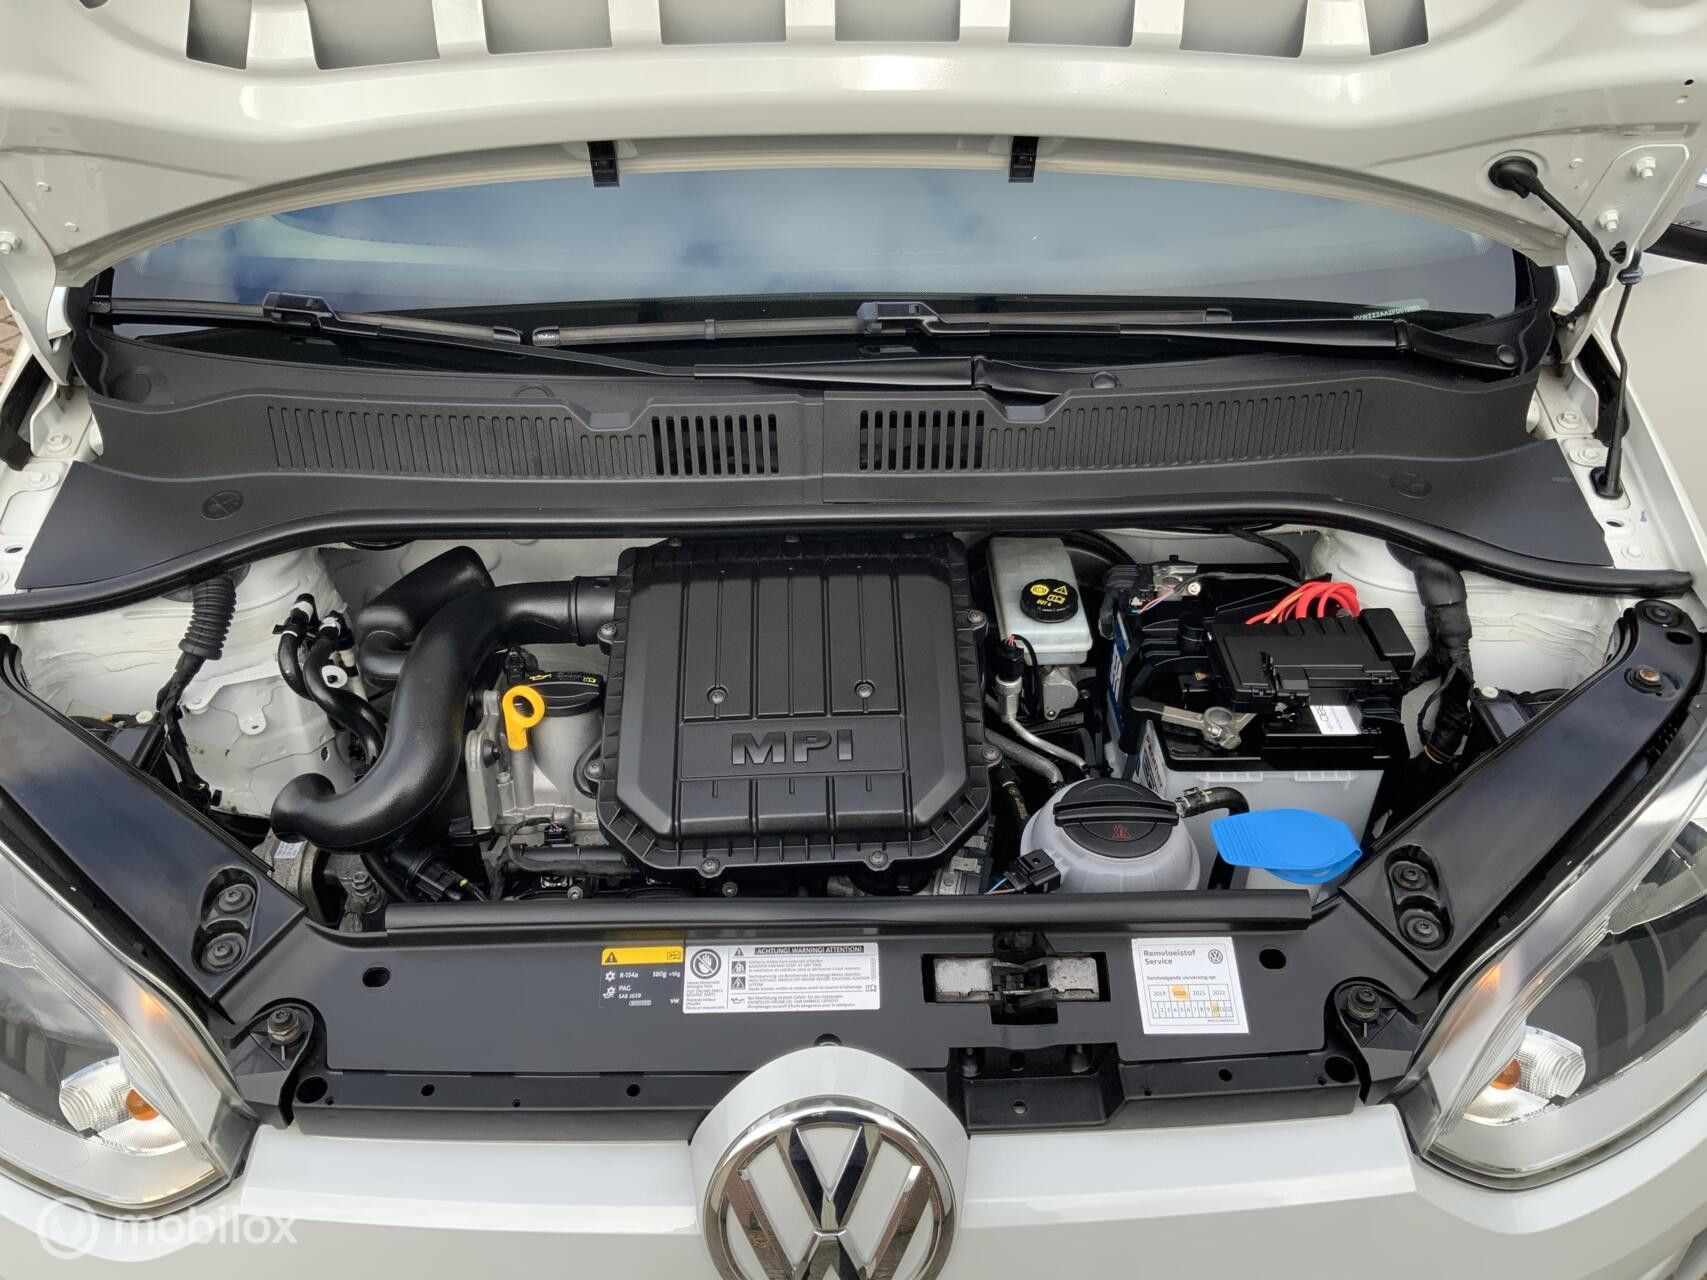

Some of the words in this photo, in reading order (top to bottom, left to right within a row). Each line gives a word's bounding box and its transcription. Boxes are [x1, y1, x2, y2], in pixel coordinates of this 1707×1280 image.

[731, 728, 854, 766] MPI
[757, 947, 790, 955] ACHTUNG!
[792, 946, 825, 954] WARNING!
[825, 945, 862, 954] ATTENTION!
